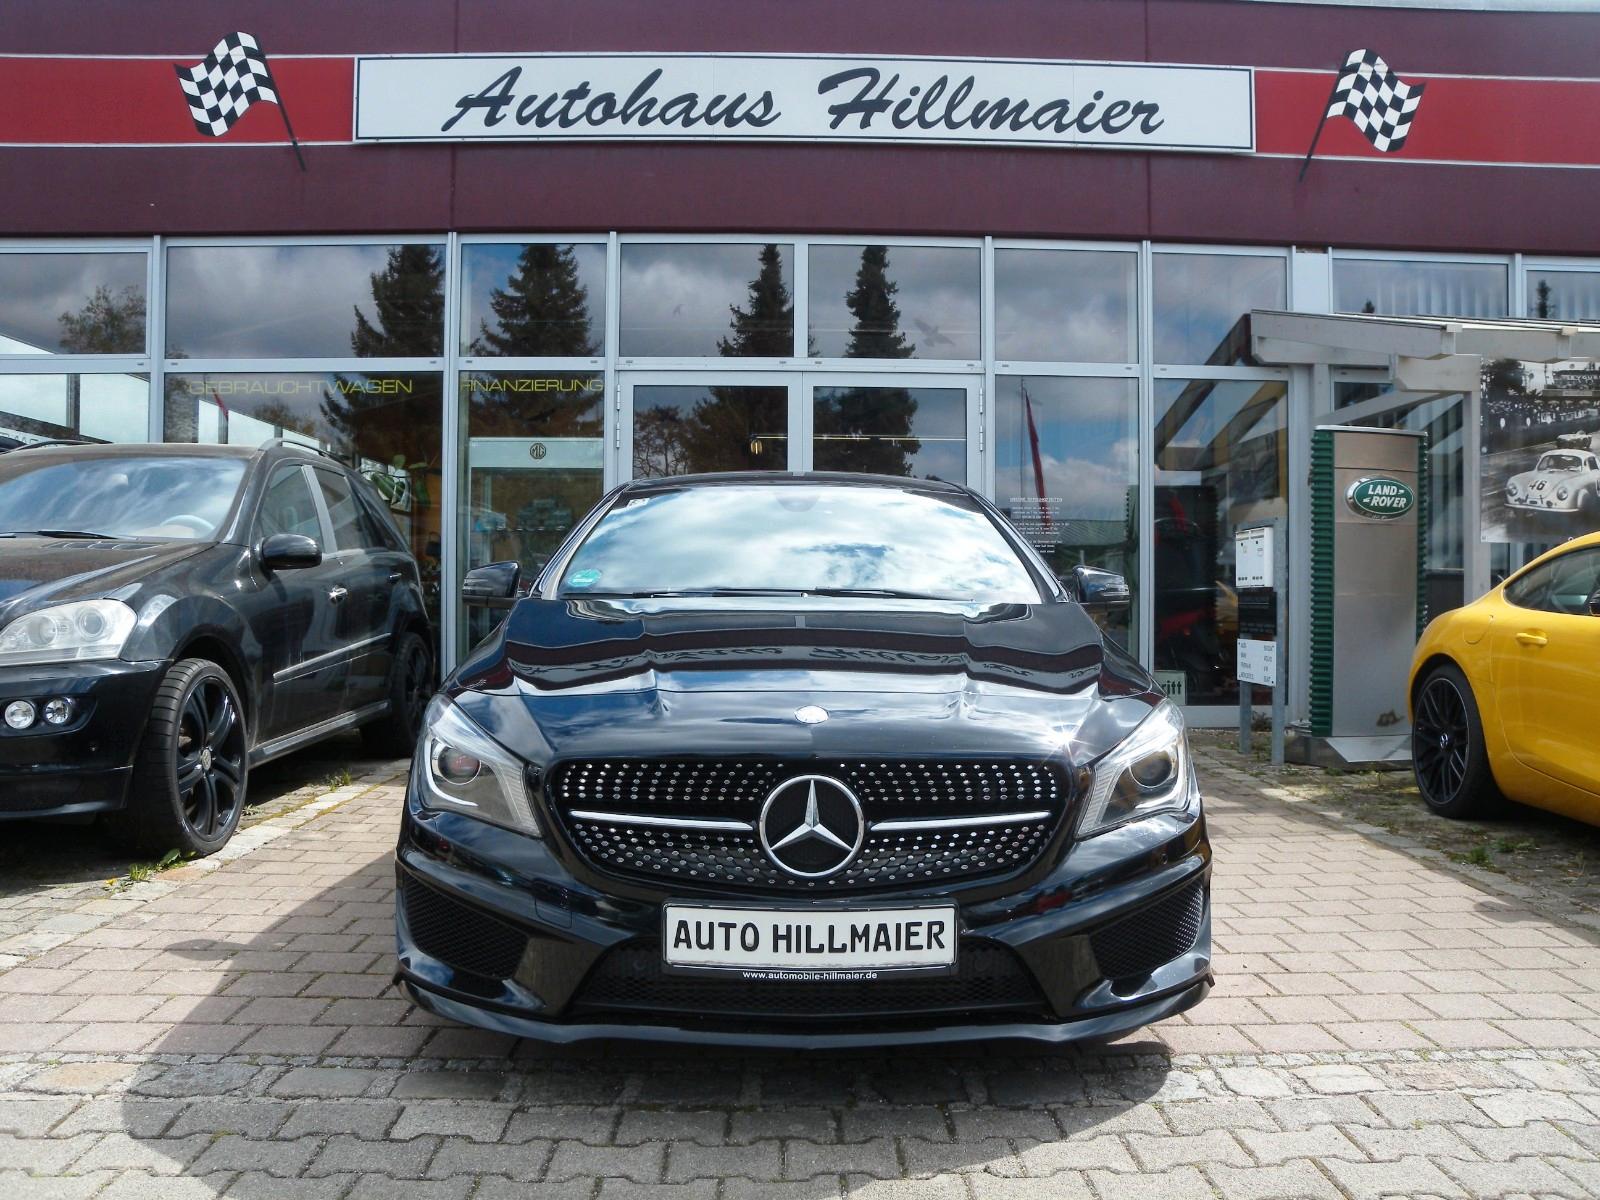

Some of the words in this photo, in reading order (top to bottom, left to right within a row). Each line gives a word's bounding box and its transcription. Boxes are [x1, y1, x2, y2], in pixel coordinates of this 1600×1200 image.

[441, 66, 781, 132] Autohaus
[818, 68, 1165, 135] Hillmaier
[189, 380, 413, 395] GEBRAUCHTWAGEN
[461, 379, 604, 392] FINANZIERUNG
[531, 444, 545, 458] MG
[1367, 484, 1398, 496] LAND
[1370, 496, 1407, 508] ROVER
[1161, 680, 1182, 695] ritt
[674, 920, 760, 951] AUTO
[773, 920, 945, 954] HILLMAIER
[742, 970, 878, 981] www.automobile-hillmaier.de
